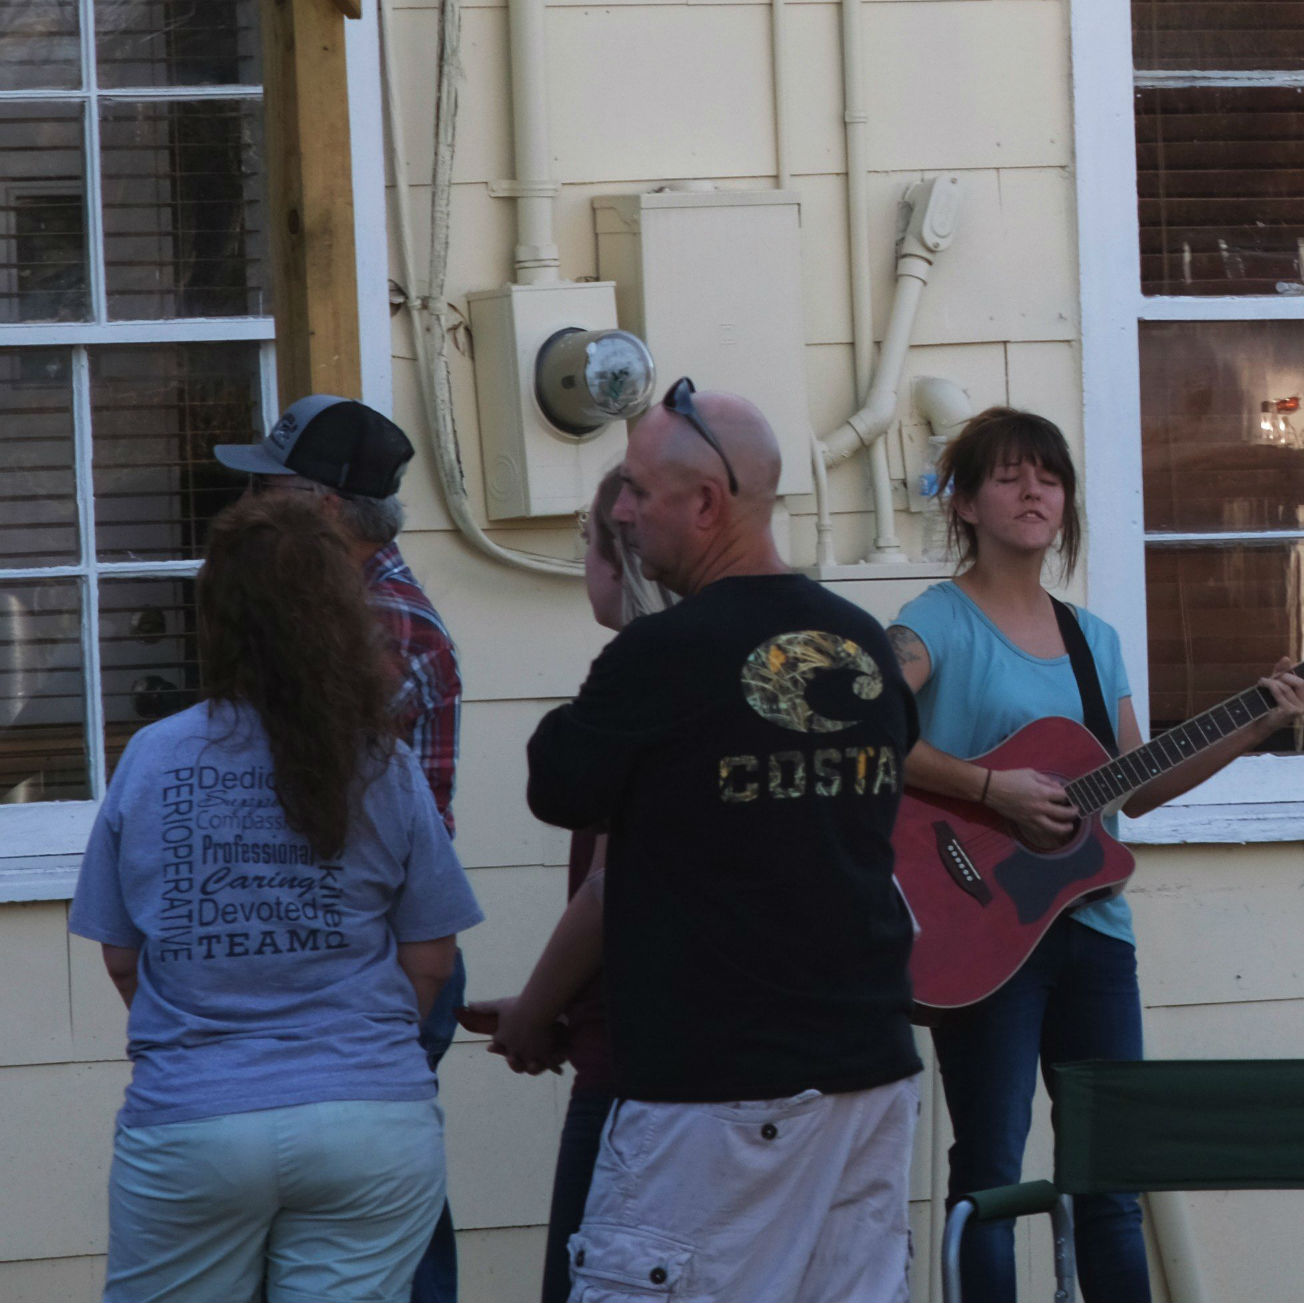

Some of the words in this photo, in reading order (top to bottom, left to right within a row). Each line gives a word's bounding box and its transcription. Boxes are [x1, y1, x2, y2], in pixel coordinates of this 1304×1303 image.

[198, 766, 276, 789] Dedic
[719, 746, 897, 802] COSTA
[196, 810, 288, 832] Compass
[160, 767, 194, 962] PERIOPERATIVE
[200, 867, 318, 897] Caring
[198, 896, 319, 927] Devoted
[318, 851, 351, 949] killed
[198, 929, 321, 960] TEAM
